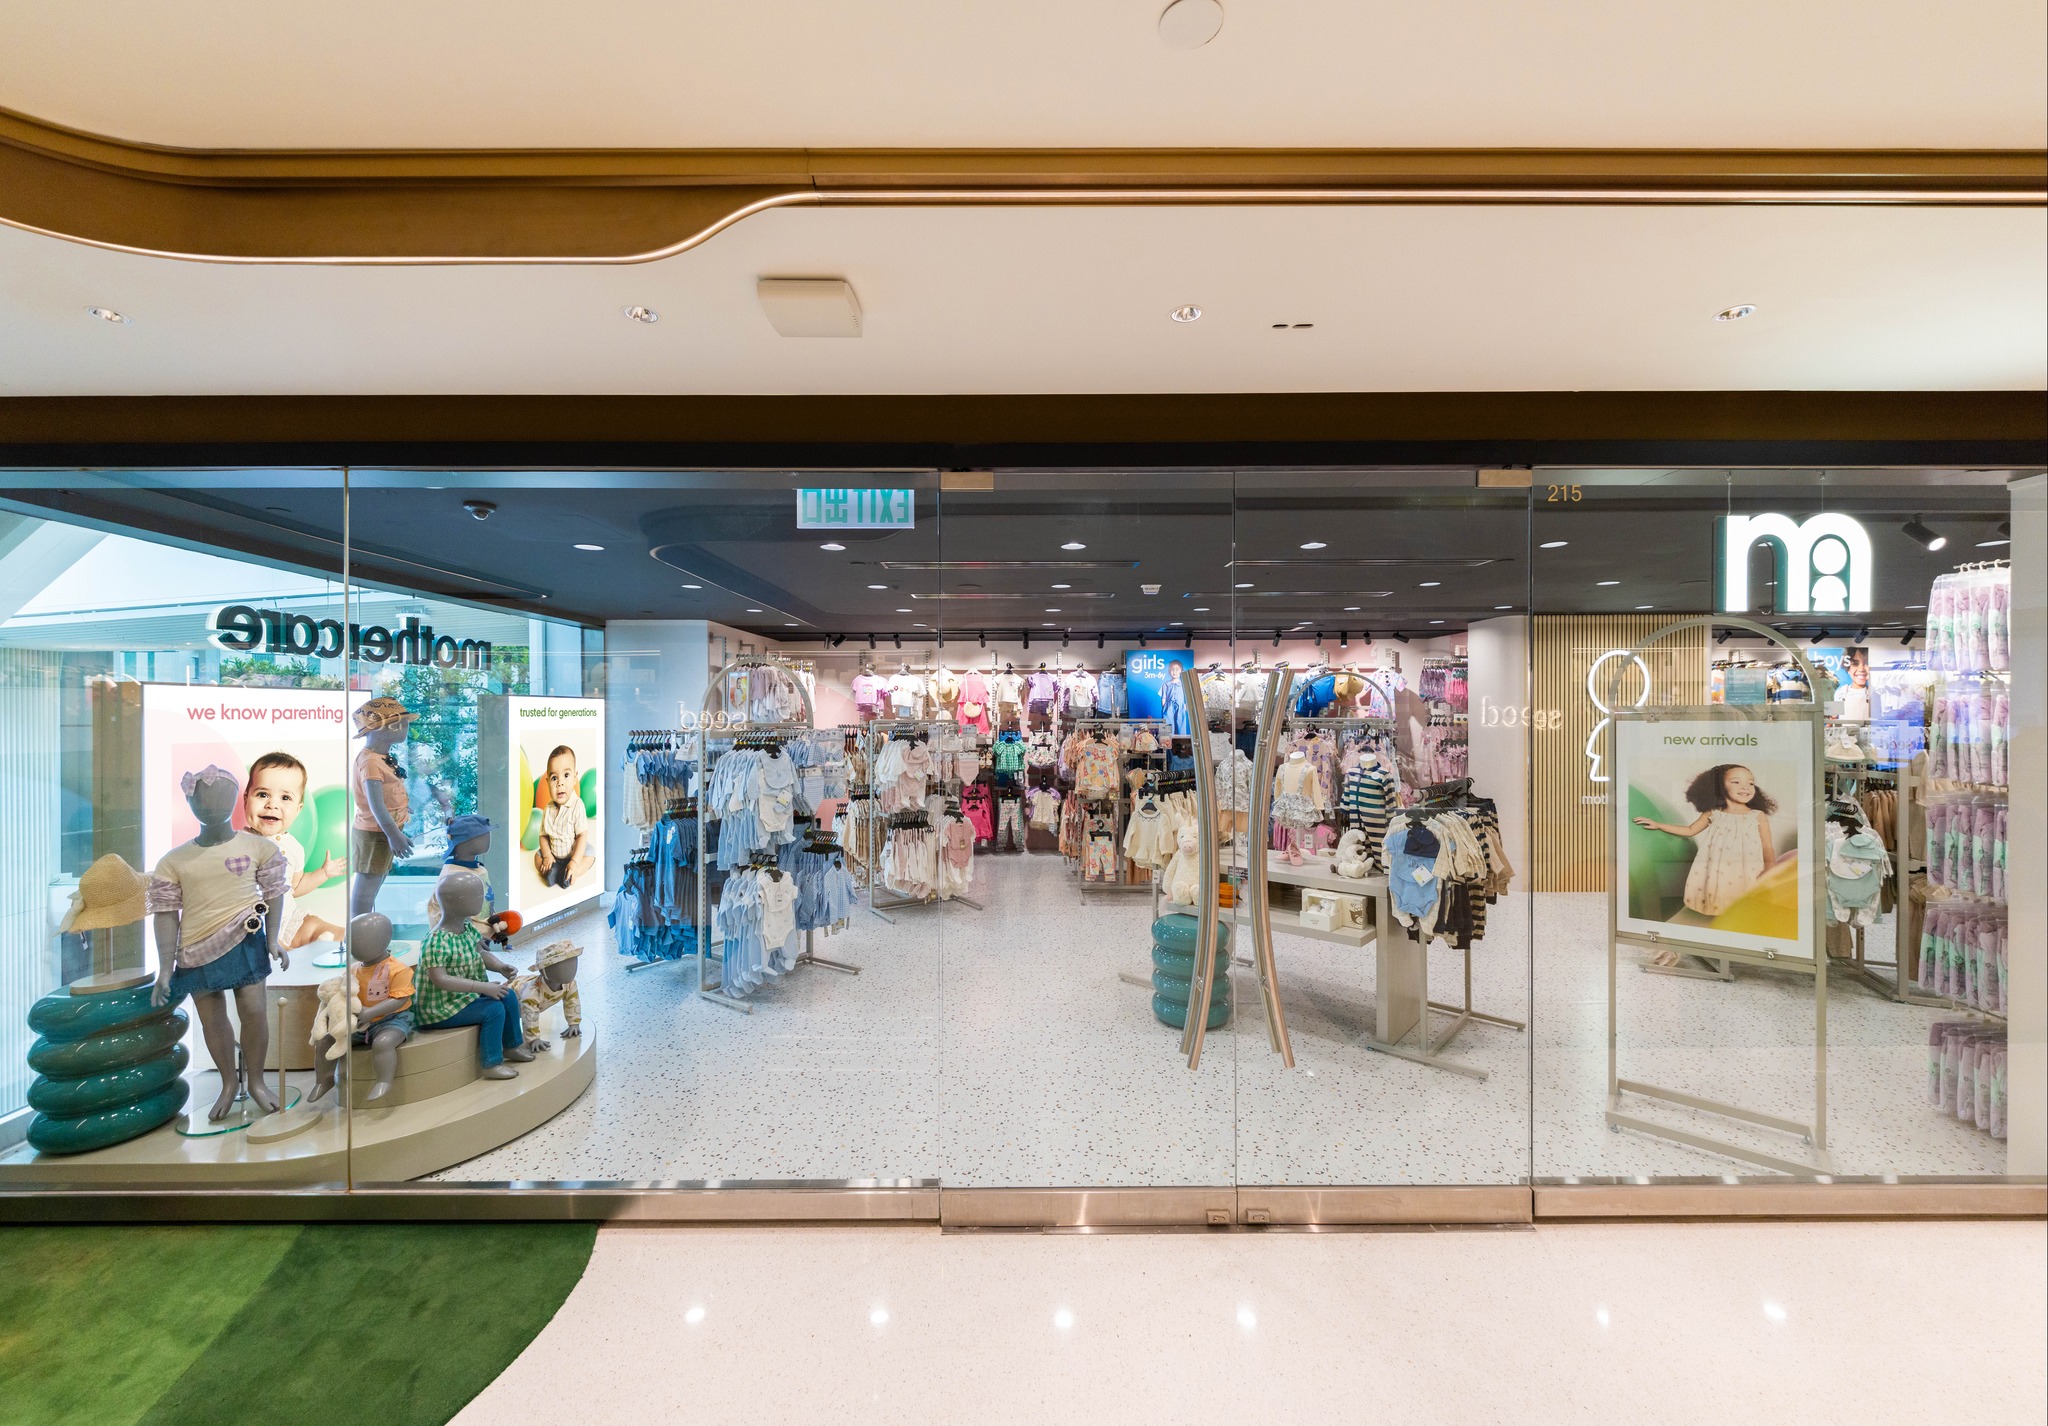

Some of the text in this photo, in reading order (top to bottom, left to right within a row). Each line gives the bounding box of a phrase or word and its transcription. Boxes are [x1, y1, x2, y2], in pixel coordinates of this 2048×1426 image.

[1547, 484, 1583, 502] 215
[1131, 654, 1165, 674] girls
[1144, 671, 1167, 680] 3m-6y
[187, 707, 216, 721] we
[221, 703, 268, 720] know
[272, 704, 344, 724] parenting
[519, 707, 597, 719] trusted for generations
[1663, 733, 1758, 746] new arrivals
